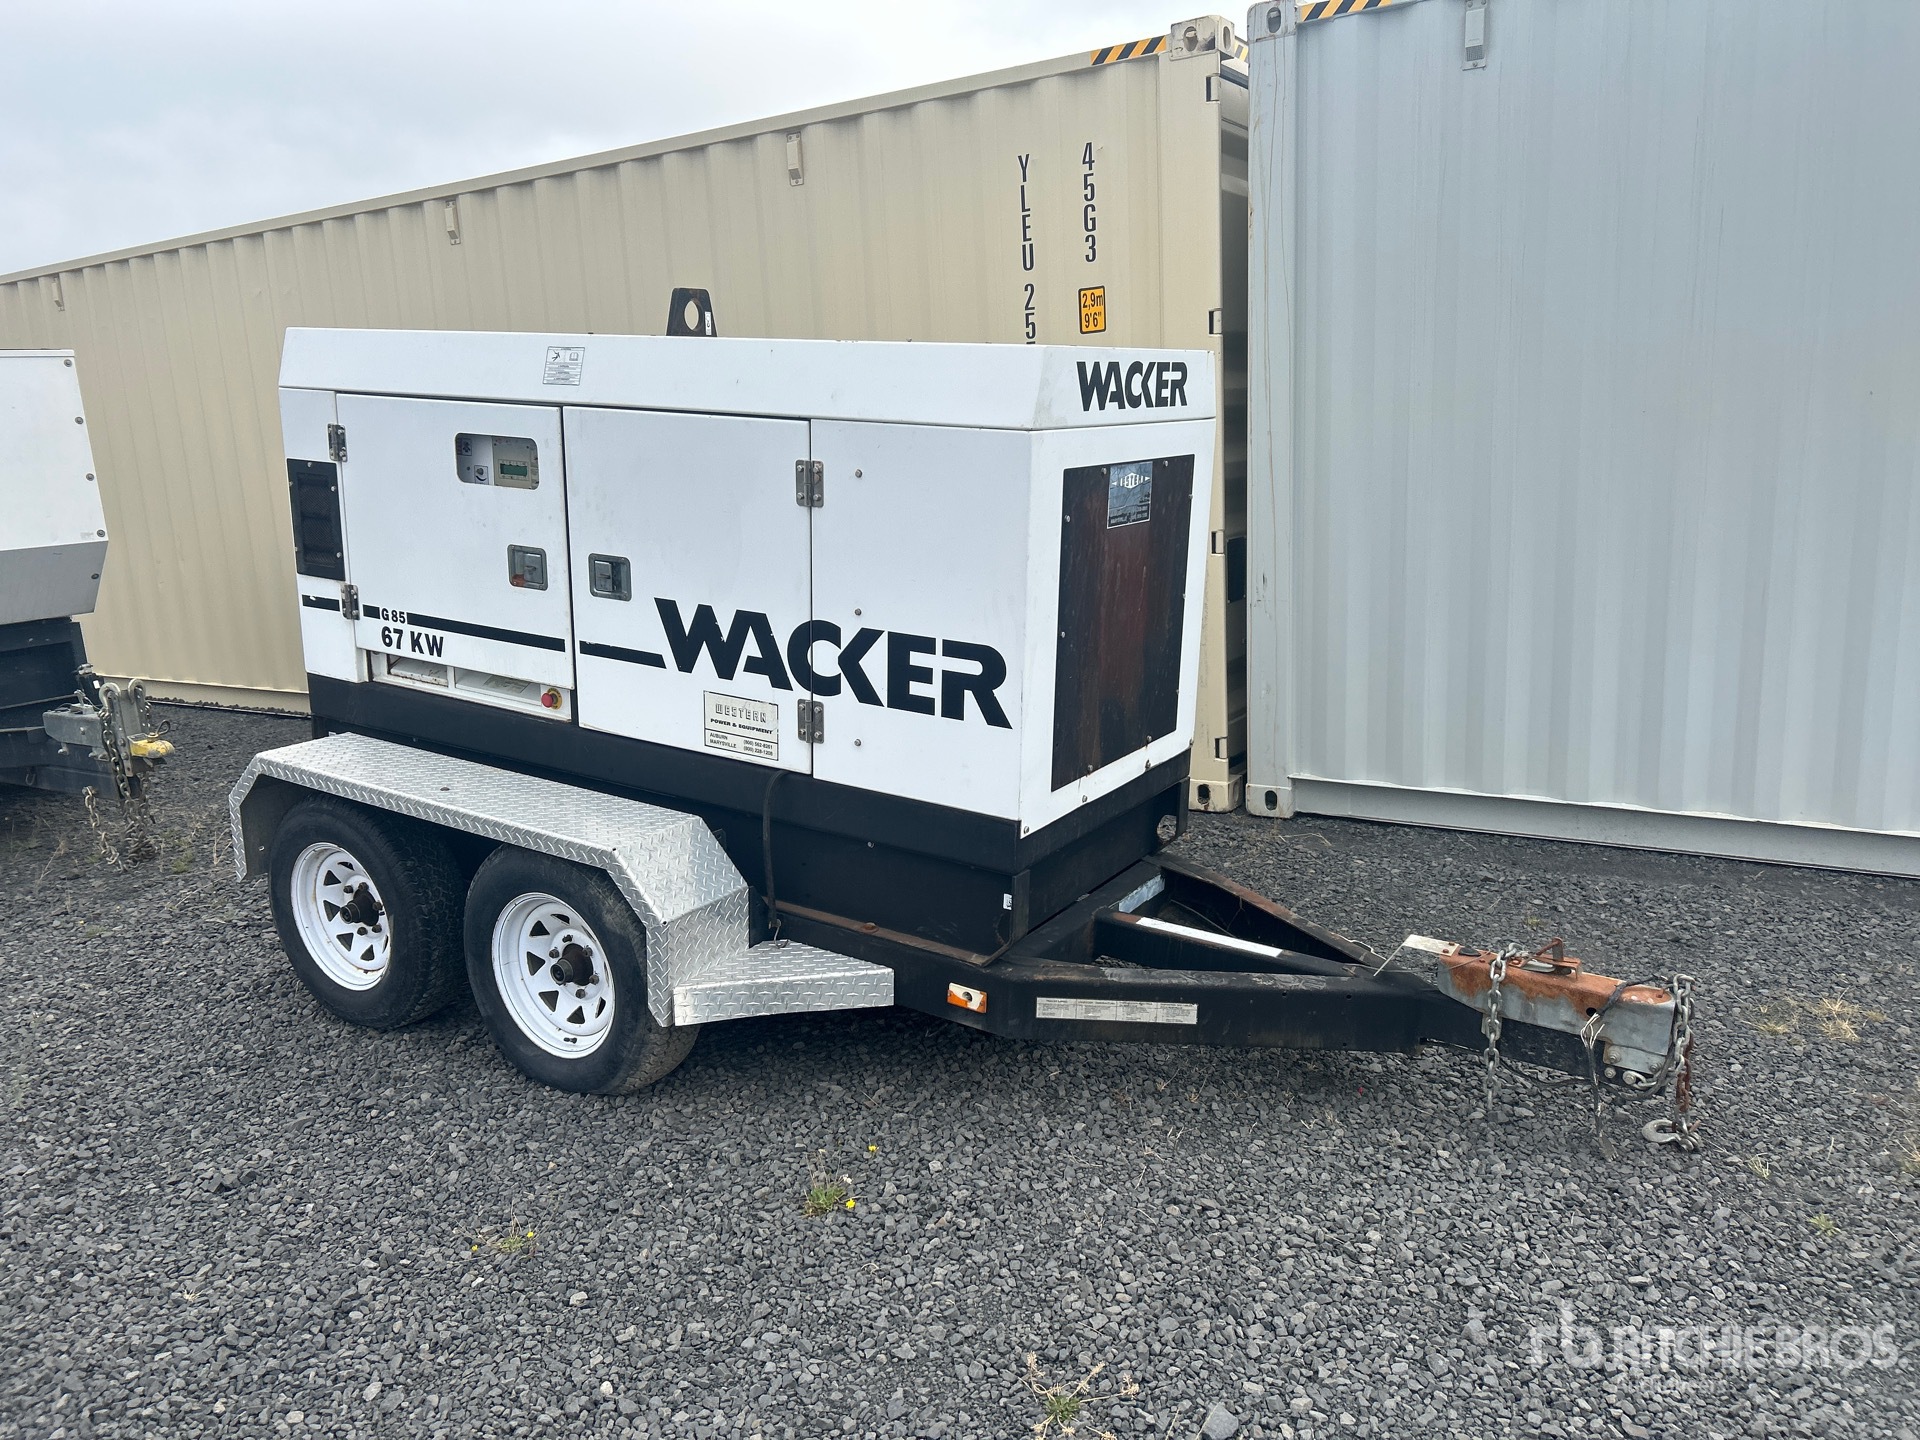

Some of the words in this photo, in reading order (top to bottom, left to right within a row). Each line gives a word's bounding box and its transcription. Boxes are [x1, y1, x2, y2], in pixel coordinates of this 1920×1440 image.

[1018, 154, 1034, 271] YLEU
[1082, 142, 1096, 263] 45G3
[1024, 283, 1036, 345] 25
[1082, 292, 1104, 311] 2,9m
[1076, 361, 1188, 412] WACKER
[381, 626, 403, 650] 67
[410, 631, 444, 658] KW
[654, 597, 1013, 730] WACKER
[710, 718, 731, 727] POWER
[738, 723, 773, 735] EQUIPMENT
[715, 703, 767, 723] WESTERN
[709, 732, 728, 741] AUBURN
[709, 738, 737, 749] MARYSVILLE
